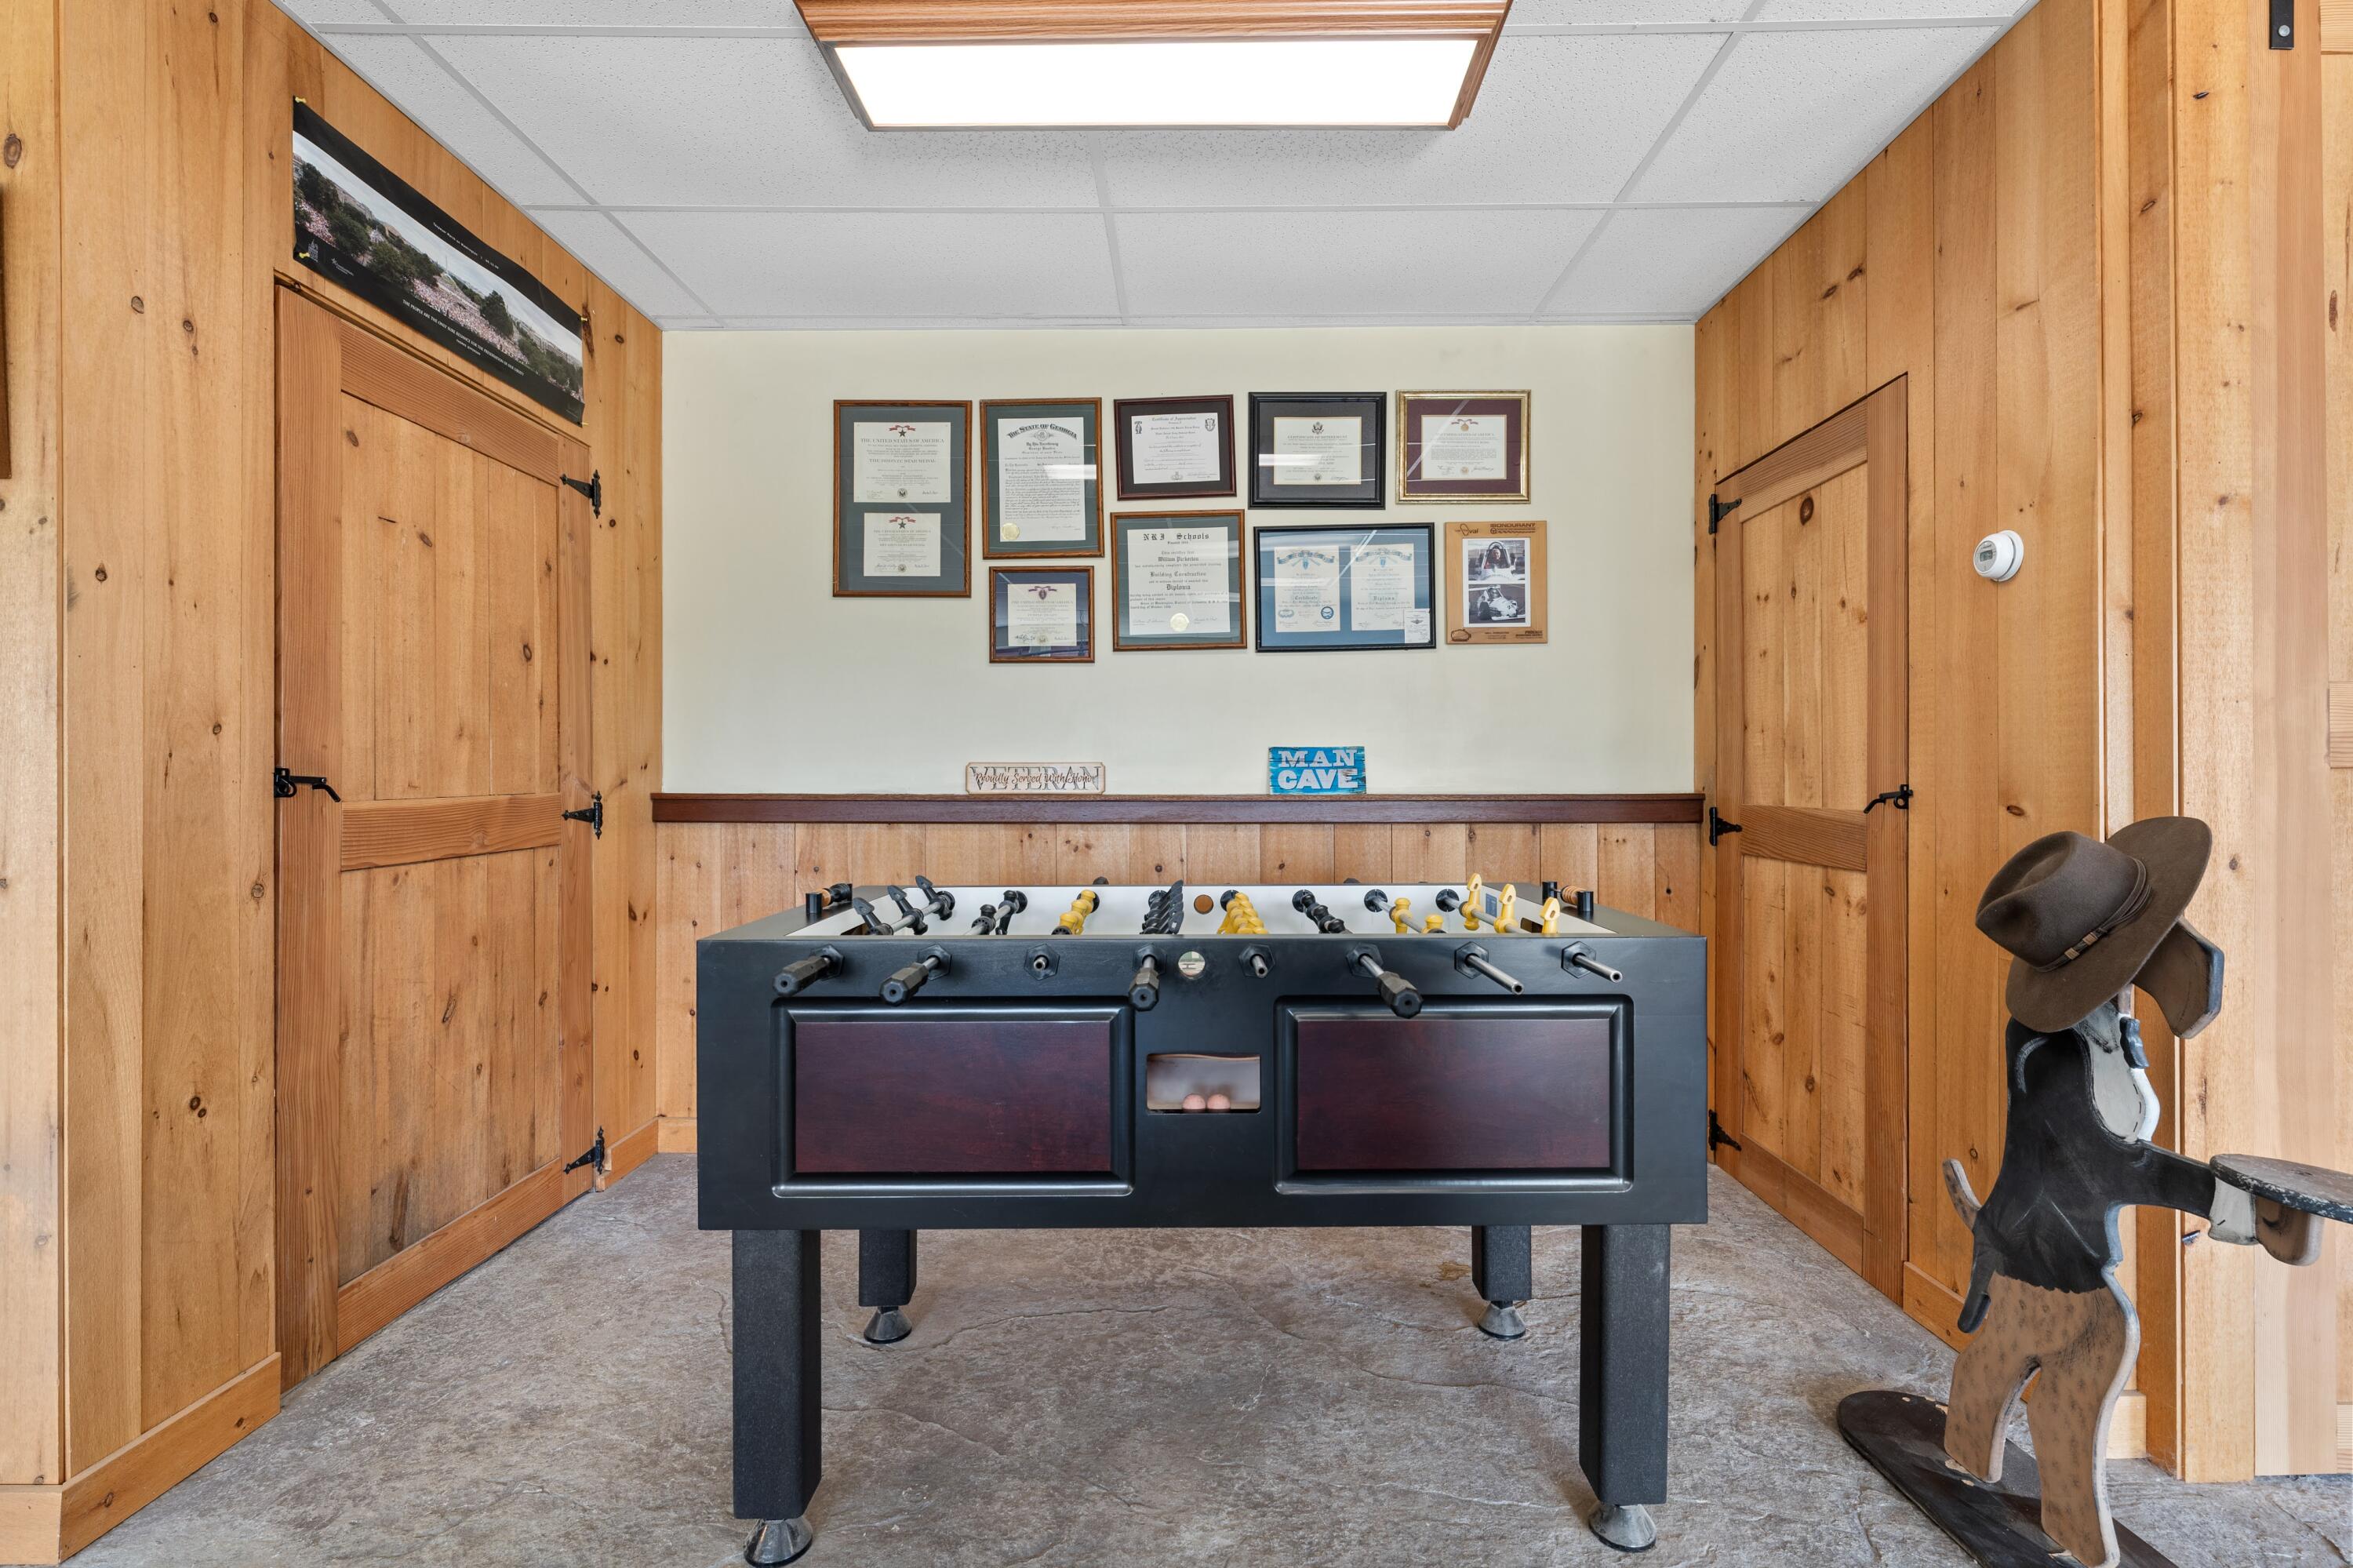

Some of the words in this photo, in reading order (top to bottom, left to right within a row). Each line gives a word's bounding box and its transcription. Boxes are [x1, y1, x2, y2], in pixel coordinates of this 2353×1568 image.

[1007, 429, 1020, 438] THE
[1020, 424, 1039, 433] STATE
[1049, 424, 1078, 440] GEORGIA
[1278, 749, 1358, 767] MAN
[969, 766, 1102, 791] VETERAN
[975, 773, 1009, 784] Proudly
[1012, 773, 1042, 784] Served
[1045, 773, 1065, 783] With
[1065, 773, 1096, 784] Honor
[1278, 769, 1358, 790] CAVE
